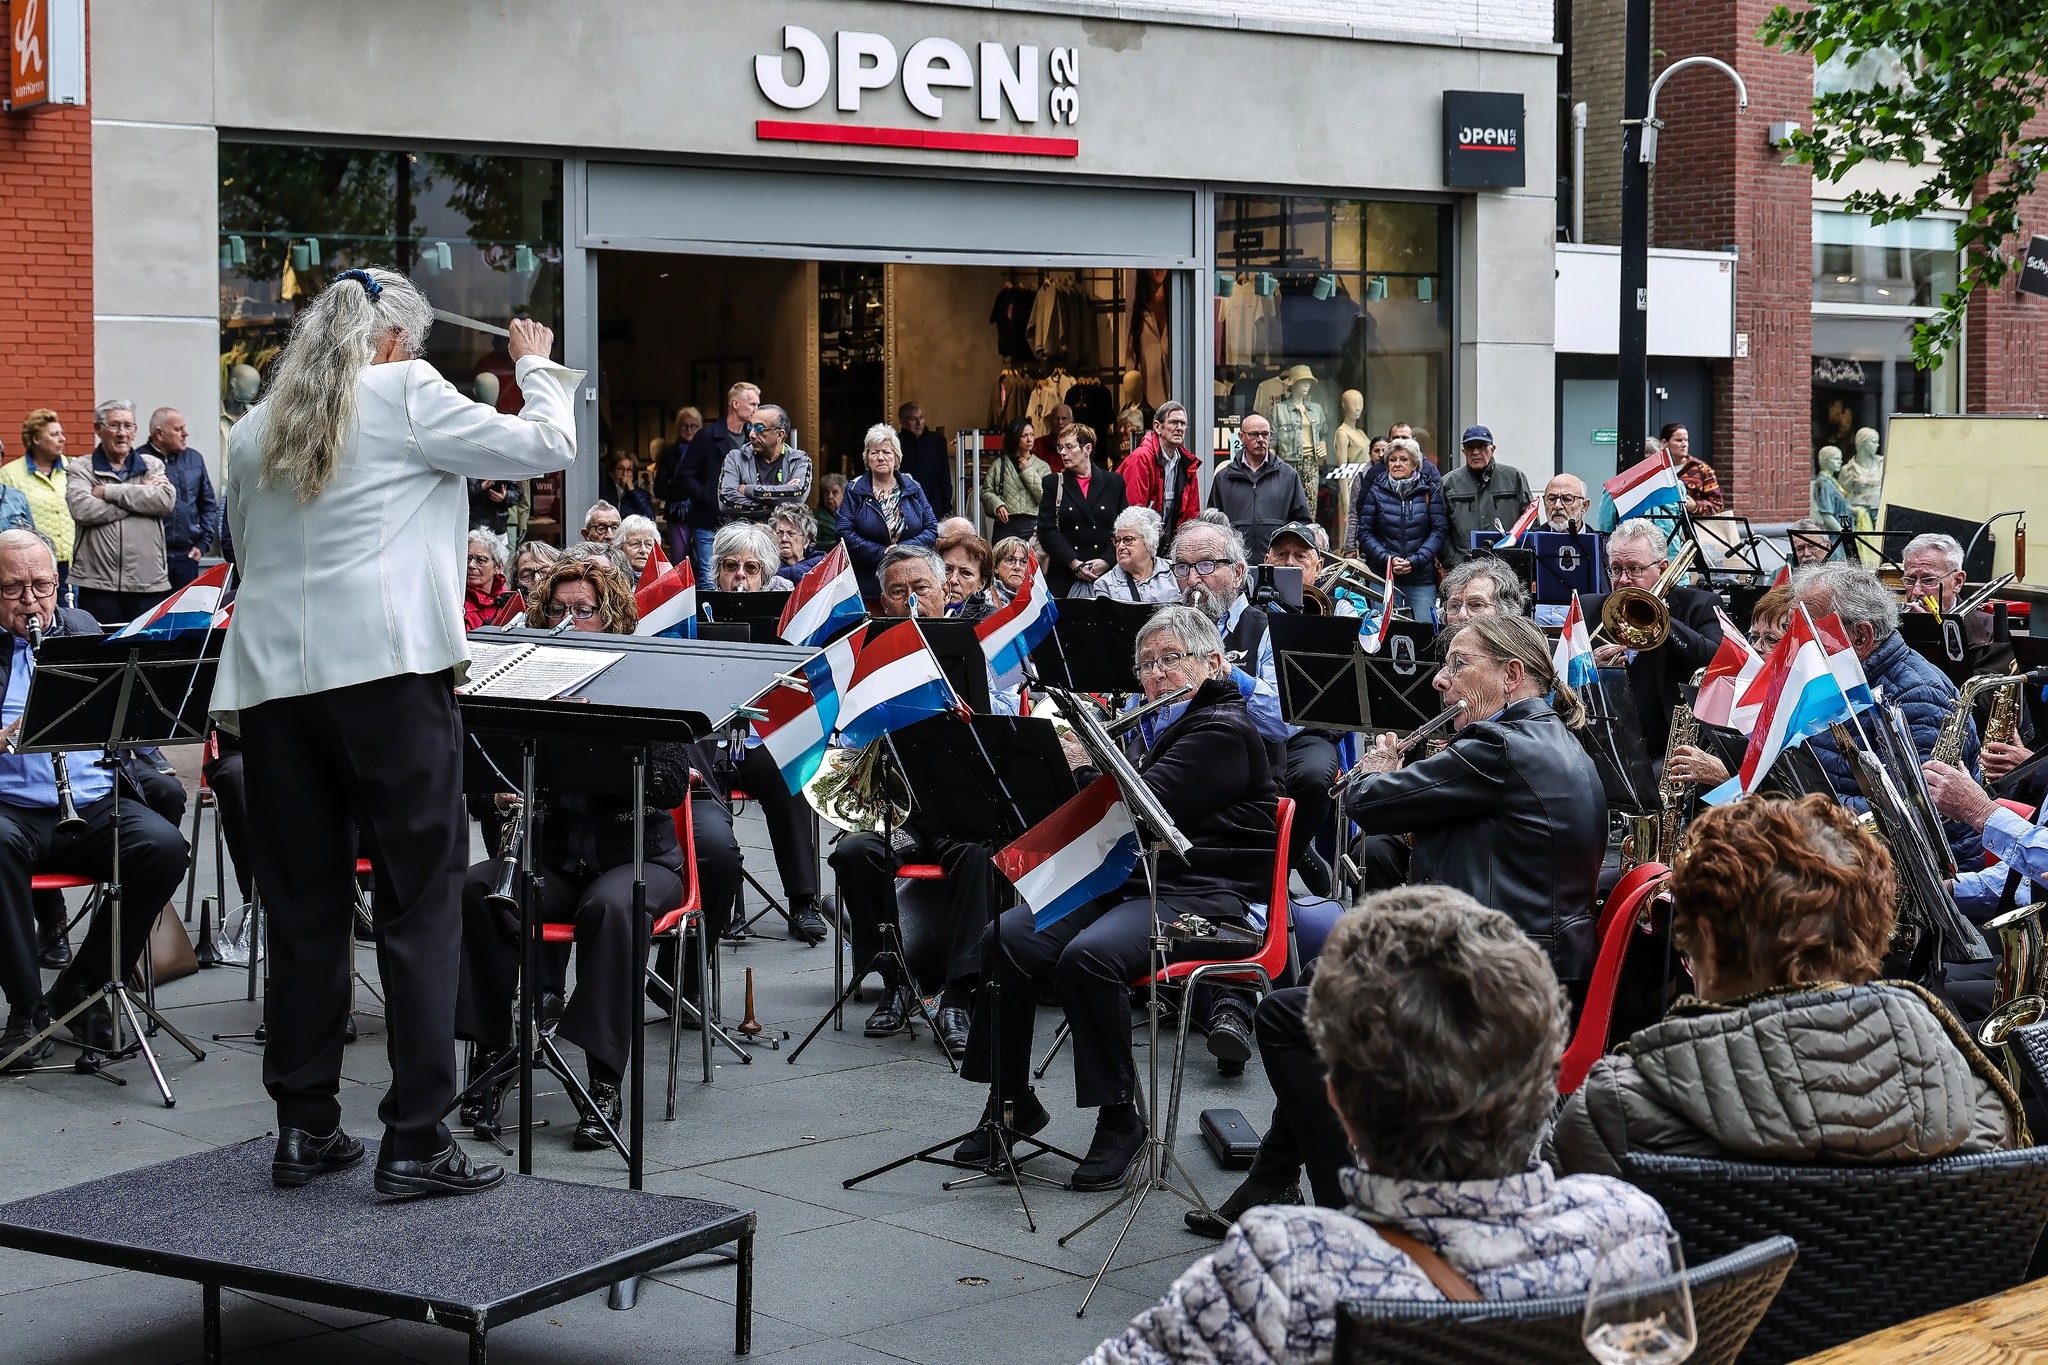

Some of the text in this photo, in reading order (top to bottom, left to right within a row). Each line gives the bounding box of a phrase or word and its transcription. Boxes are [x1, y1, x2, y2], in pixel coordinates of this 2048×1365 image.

[15, 80, 44, 98] vanHaren
[1050, 46, 1080, 125] 32
[536, 482, 553, 490] WIN
